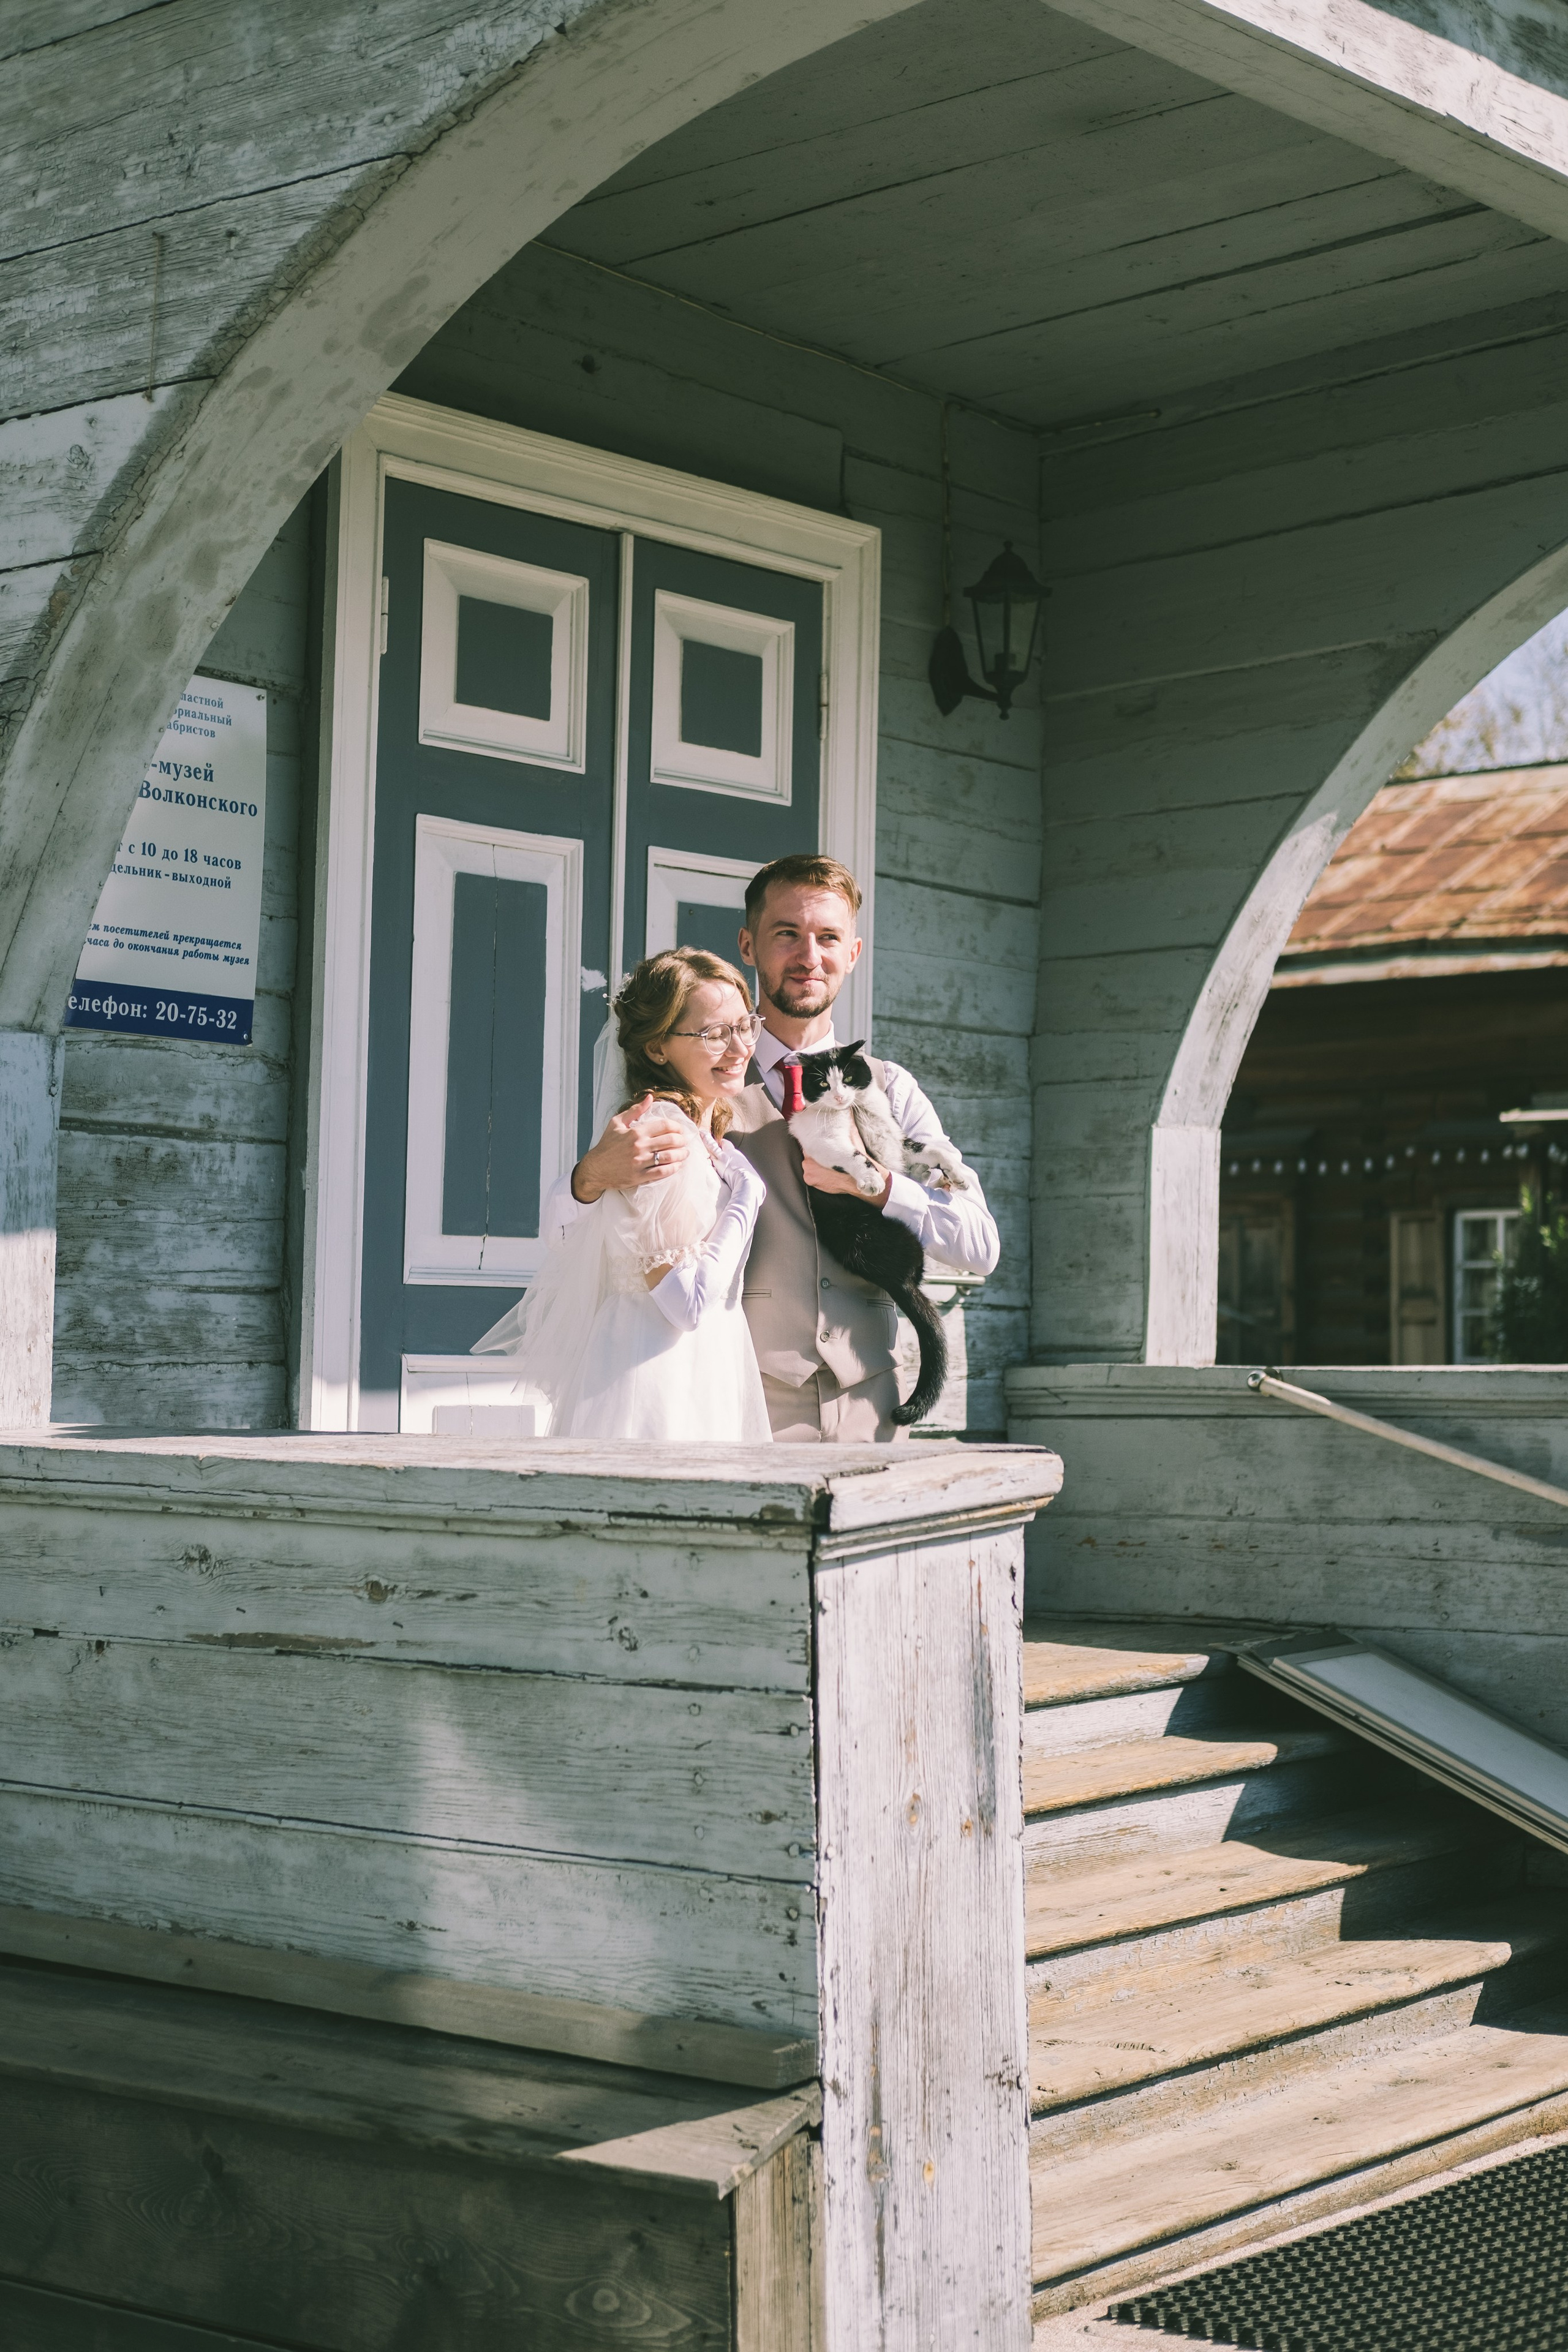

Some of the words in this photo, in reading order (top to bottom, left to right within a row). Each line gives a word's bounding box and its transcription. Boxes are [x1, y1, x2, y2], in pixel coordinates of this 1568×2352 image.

[167, 720, 216, 738] абристов
[138, 780, 258, 817] Волконского
[128, 844, 135, 854] с
[141, 842, 157, 857] 10
[162, 849, 178, 861] до
[184, 848, 198, 863] 18
[203, 855, 242, 870] часов
[103, 925, 170, 940] посетителей
[173, 934, 242, 950] прекращается
[113, 938, 124, 949] до
[127, 943, 179, 956] окончания
[181, 949, 219, 961] работы
[223, 955, 249, 965] музея
[68, 995, 148, 1020] елефон:
[156, 1001, 237, 1030] 20-75-32
